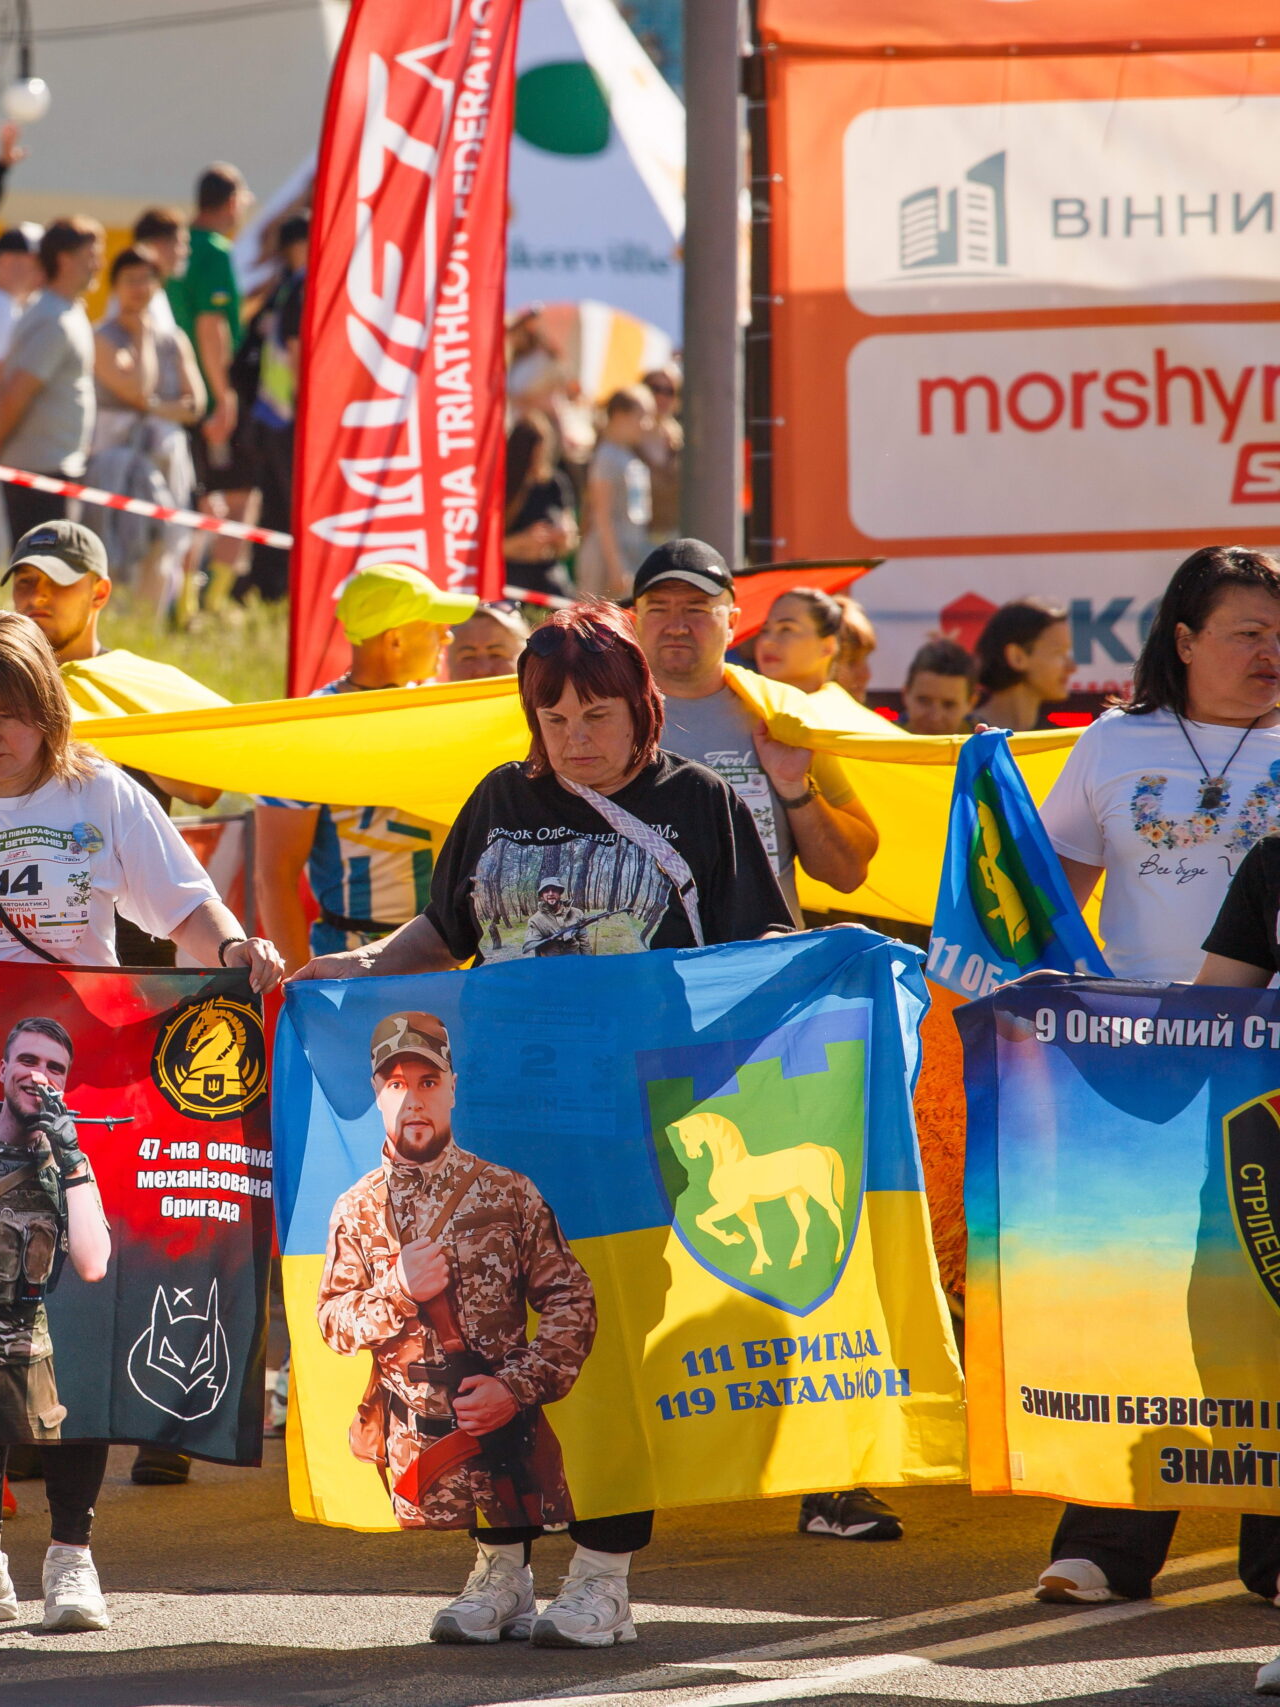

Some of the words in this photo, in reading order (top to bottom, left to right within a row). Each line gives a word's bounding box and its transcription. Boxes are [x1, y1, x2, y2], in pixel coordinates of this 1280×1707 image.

[440, 464, 480, 594] YTSIA
[5, 837, 64, 849] ВЕТЕРАНІВ
[1035, 1007, 1057, 1044] 9
[1066, 1012, 1234, 1049] Окремий
[137, 1167, 272, 1199] механізована
[161, 1196, 240, 1223] бригада
[681, 1344, 735, 1378] 111
[741, 1329, 882, 1369] БРИГАДА
[656, 1387, 716, 1421] 119
[1020, 1385, 1111, 1423] ЗНИКЛІ
[1116, 1395, 1255, 1428] БЕЗВІСТИ
